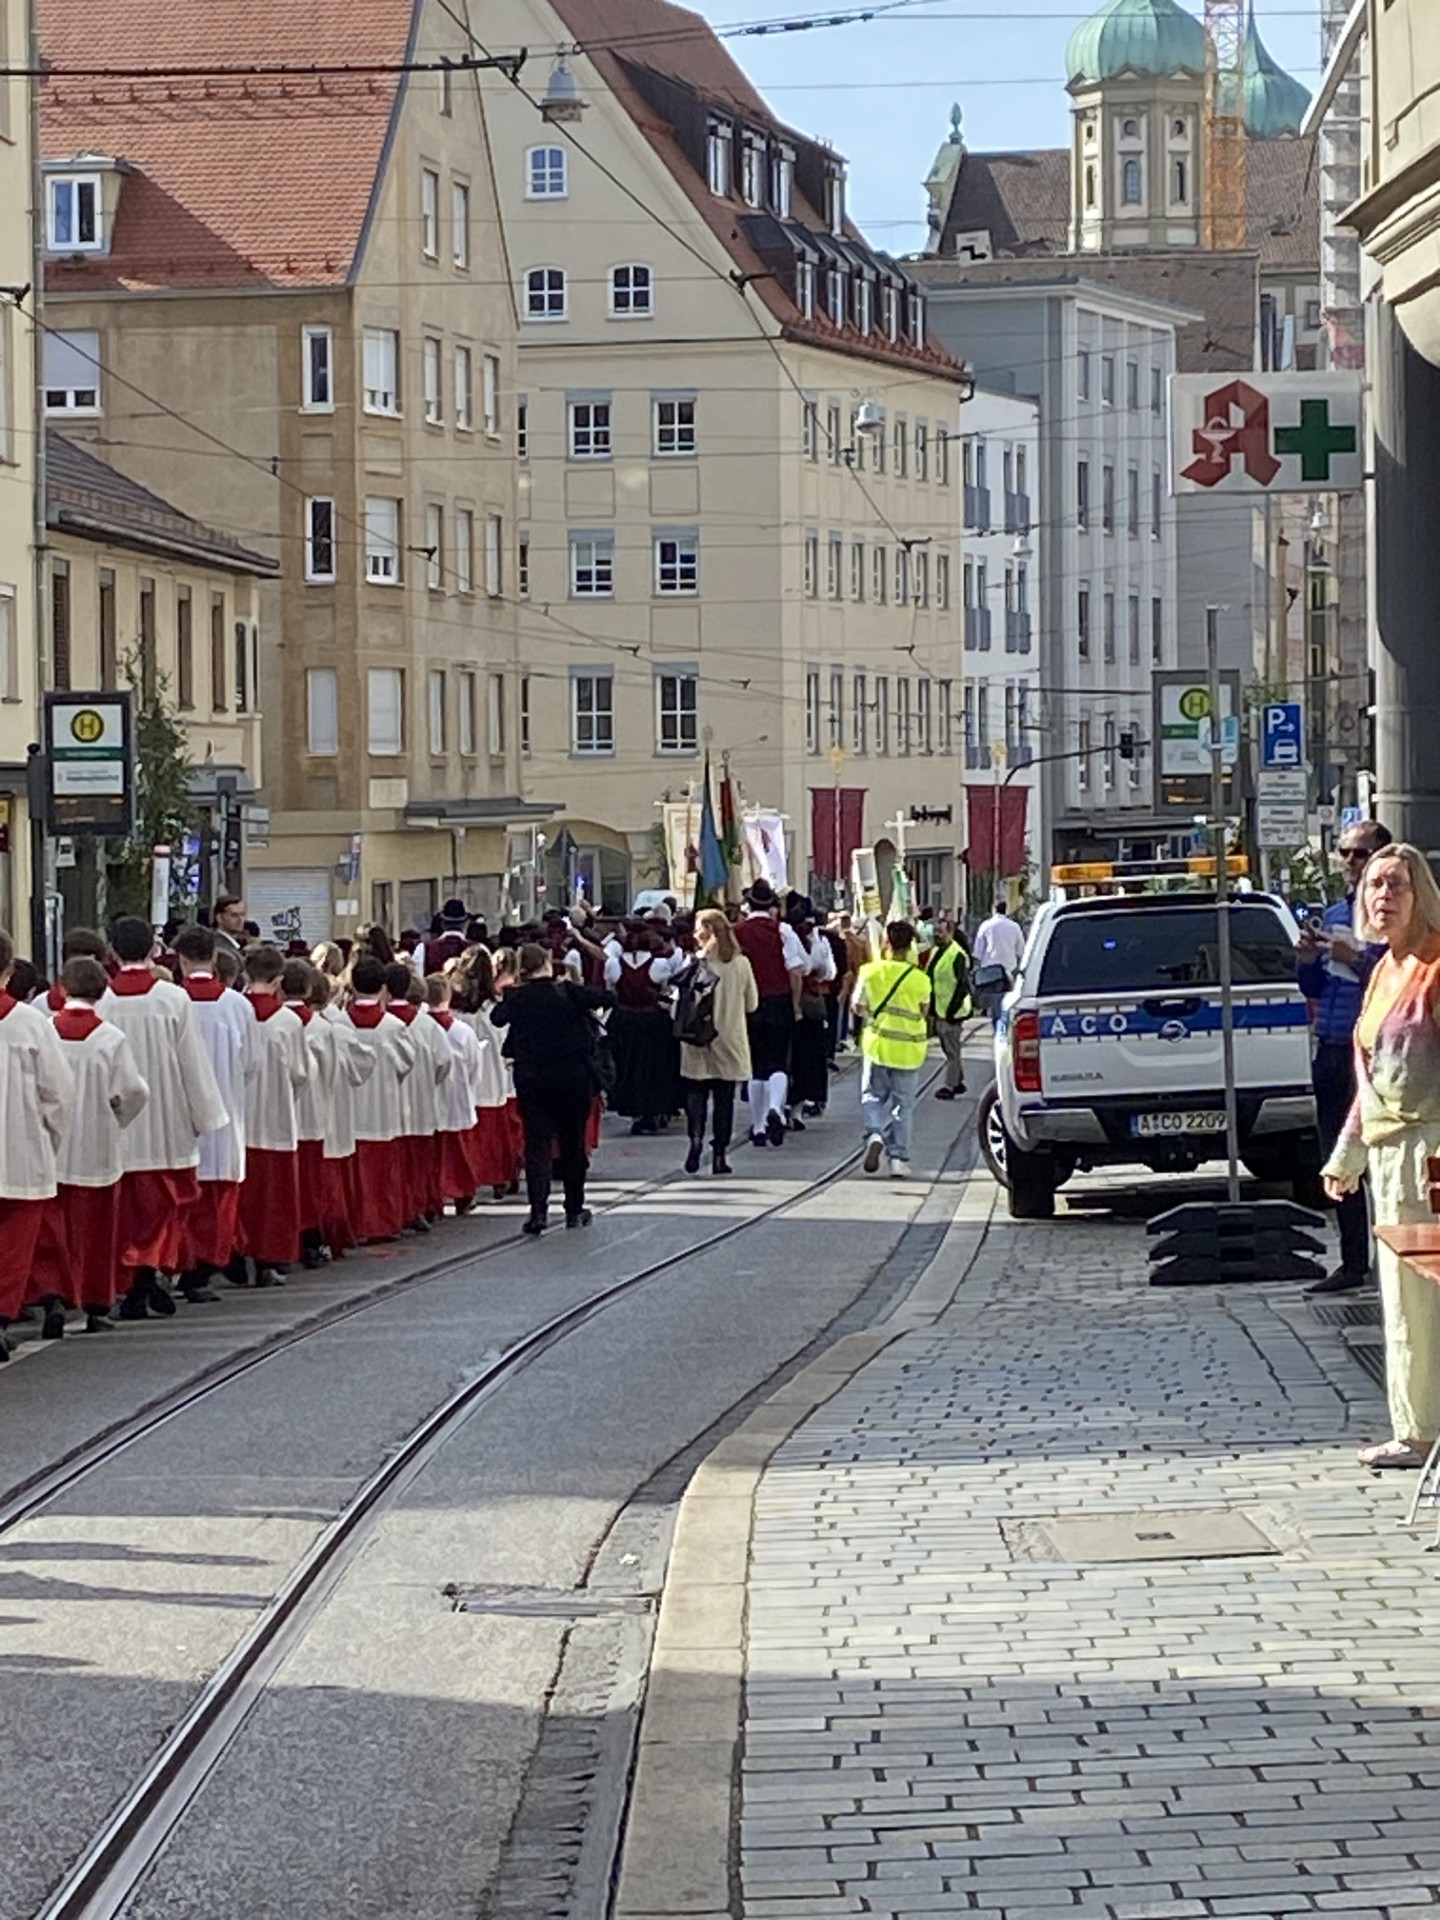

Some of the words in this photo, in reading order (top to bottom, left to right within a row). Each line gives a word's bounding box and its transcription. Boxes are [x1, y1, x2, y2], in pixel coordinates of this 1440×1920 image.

[1189, 696, 1205, 713] H
[80, 718, 96, 736] H
[1267, 708, 1286, 734] P
[1186, 1113, 1226, 1129] 2209
